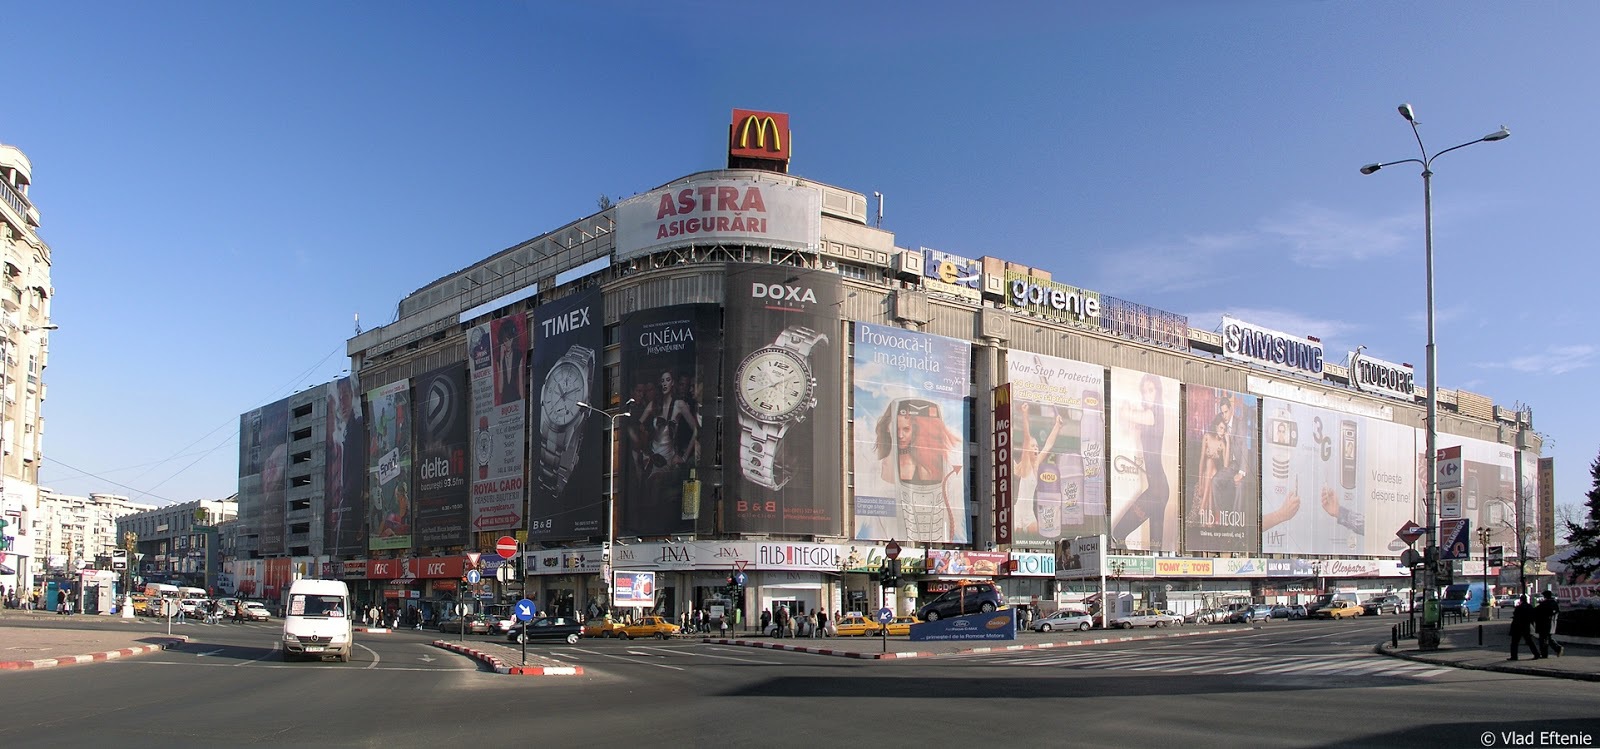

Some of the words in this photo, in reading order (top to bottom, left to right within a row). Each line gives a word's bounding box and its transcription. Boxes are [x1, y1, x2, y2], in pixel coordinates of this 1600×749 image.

[657, 186, 767, 220] ASTRA
[657, 212, 767, 239] ASIGURĂRI
[925, 249, 981, 289] best
[752, 282, 818, 304] DOXA
[1011, 279, 1100, 321] gorenje
[541, 306, 591, 338] TIMEX
[639, 326, 694, 347] CINÉMA
[1224, 323, 1323, 374] SAMSUNG
[1010, 360, 1055, 381] Non-Stop
[1058, 369, 1101, 385] Protection
[1359, 358, 1415, 395] TUBORG
[443, 478, 464, 488] 93.5fm
[473, 481, 497, 496] ROYAL
[500, 477, 522, 492] CARO
[1371, 488, 1395, 502] despre
[1397, 490, 1411, 504] tine!
[737, 501, 748, 512] B
[752, 503, 761, 512] &
[533, 520, 539, 530] B
[1199, 508, 1215, 526] ALB
[1219, 510, 1245, 527] NEGRU
[1443, 520, 1465, 552] FLAMINGO
[619, 550, 634, 559] INA
[662, 546, 689, 562] INA
[719, 547, 738, 558] INA
[793, 545, 838, 566] NEGRU
[1079, 543, 1098, 553] NICHI
[374, 563, 389, 575] KFC
[427, 563, 446, 575] KFC
[1158, 562, 1180, 572] TOMY
[1191, 563, 1210, 572] TOYS
[1331, 561, 1366, 574] Cleopatra
[786, 572, 801, 580] INA
